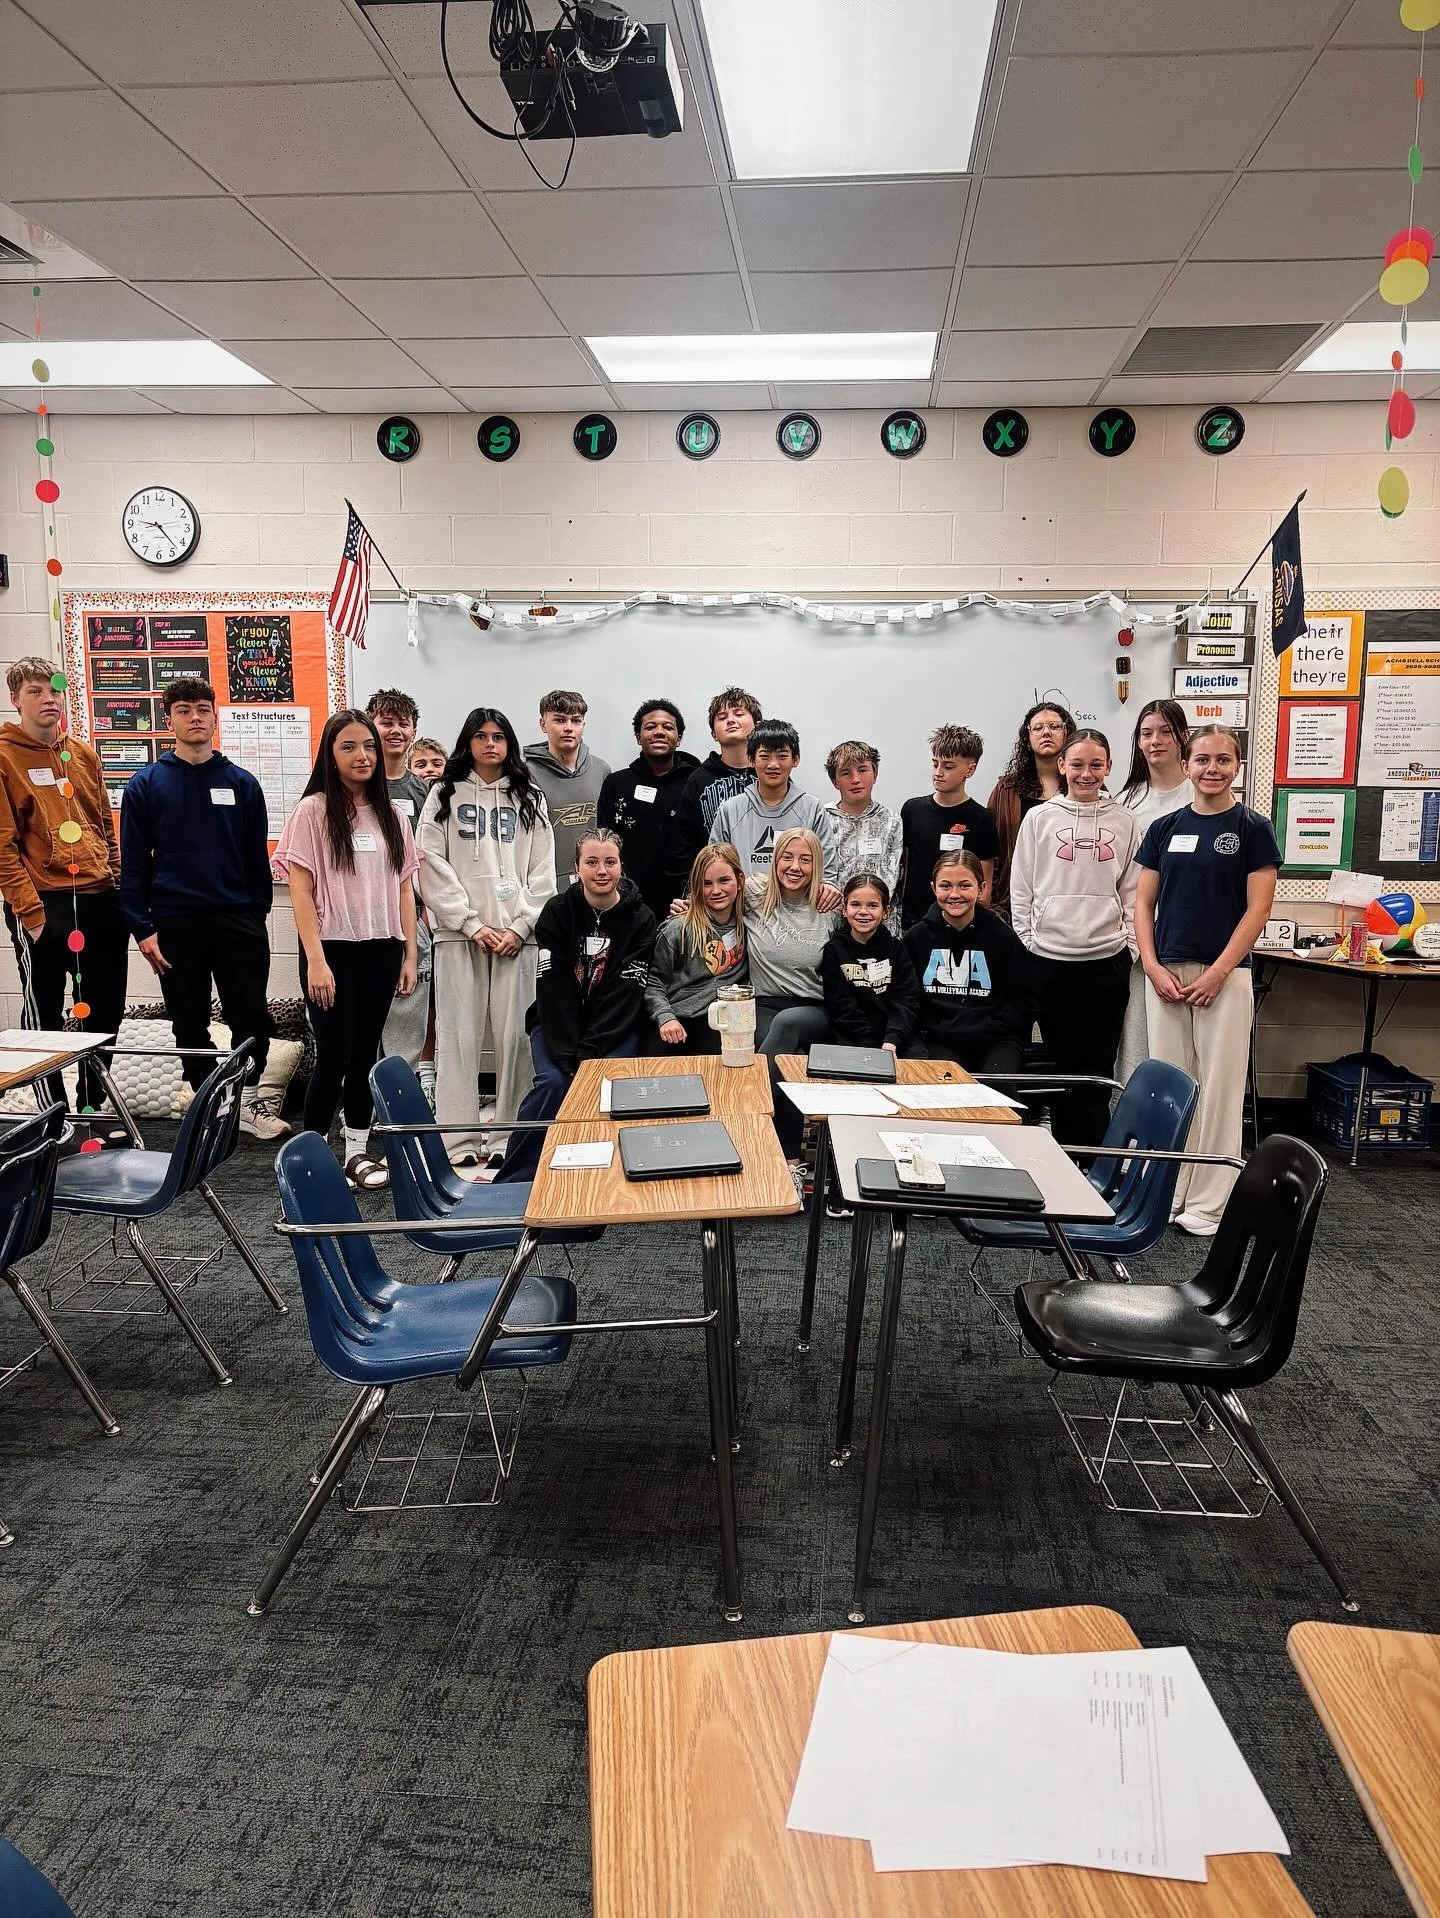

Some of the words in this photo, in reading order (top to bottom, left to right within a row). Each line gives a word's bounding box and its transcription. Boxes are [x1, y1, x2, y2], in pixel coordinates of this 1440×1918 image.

[388, 426, 410, 454] R
[489, 426, 512, 454] S
[585, 424, 606, 454] T
[688, 421, 709, 454] U
[788, 421, 811, 451] V
[888, 420, 918, 451] W
[993, 419, 1016, 450] X
[1101, 418, 1123, 450] Y
[1207, 418, 1232, 447] Z
[142, 495, 150, 505] 11
[155, 491, 165, 501] 12
[170, 497, 175, 507] 1
[130, 505, 140, 515] 10
[180, 508, 187, 518] 2
[127, 519, 134, 529] 9
[184, 523, 191, 533] 3
[131, 533, 138, 543] 8
[179, 537, 186, 546] 4
[142, 545, 149, 555] 7
[155, 549, 162, 559] 6
[169, 547, 176, 557] 5
[246, 649, 269, 659] TRY
[1197, 644, 1236, 656] Pronouns
[1297, 645, 1344, 661] there
[242, 660, 258, 669] you
[259, 657, 277, 666] will
[245, 677, 278, 687] KNOW
[1186, 675, 1239, 689] Adjective
[1293, 669, 1346, 686] they're
[231, 712, 249, 720] Text
[251, 711, 296, 721] Structures
[1075, 710, 1097, 720] Secs
[1196, 705, 1222, 717] Verb
[457, 803, 518, 843] 98
[1278, 925, 1291, 939] 2
[968, 987, 991, 997] ACADEM
